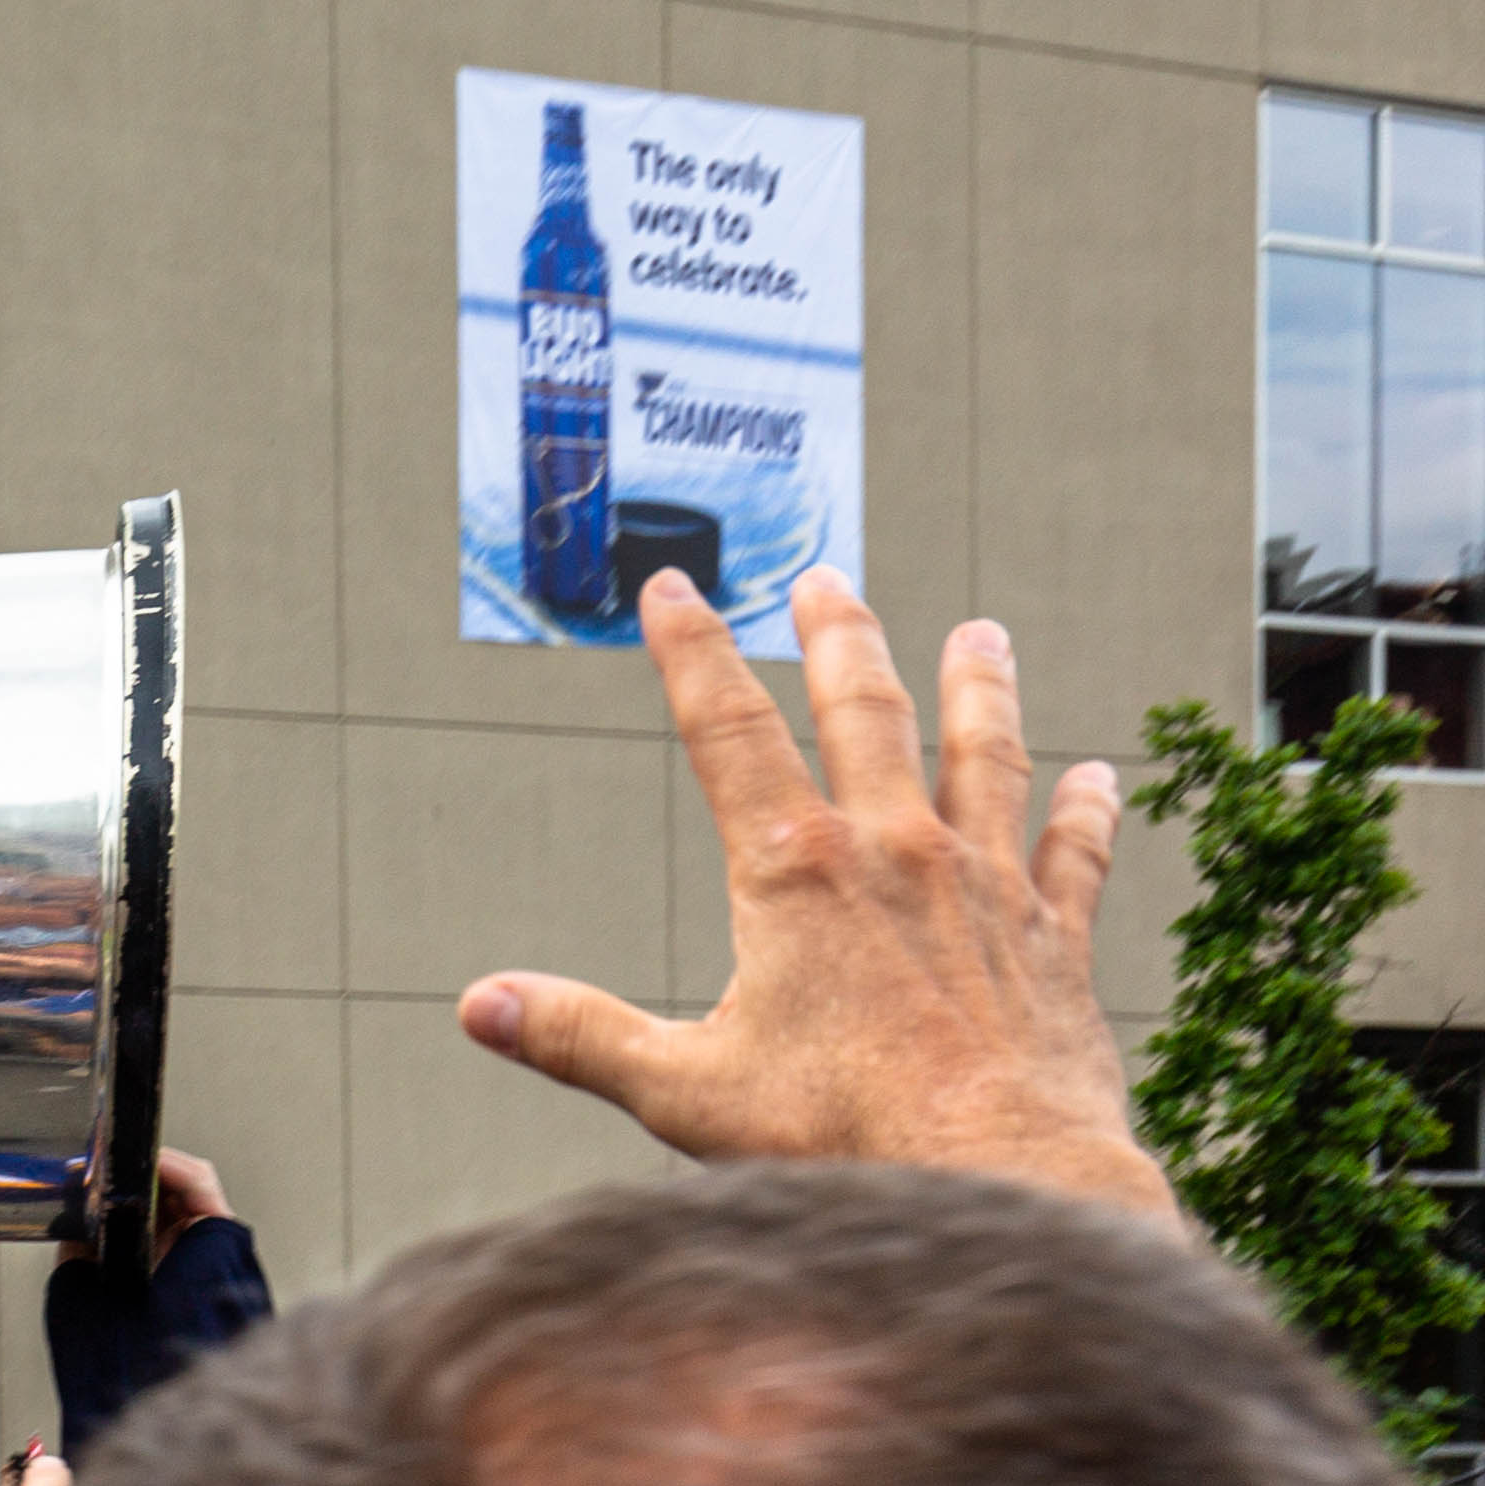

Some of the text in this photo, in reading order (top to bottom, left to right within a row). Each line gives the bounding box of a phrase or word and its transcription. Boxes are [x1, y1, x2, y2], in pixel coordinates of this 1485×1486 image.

[628, 138, 782, 208] The only
[628, 199, 751, 247] way to
[629, 247, 809, 303] celebrate.
[642, 397, 807, 458] CHAMPIONS
